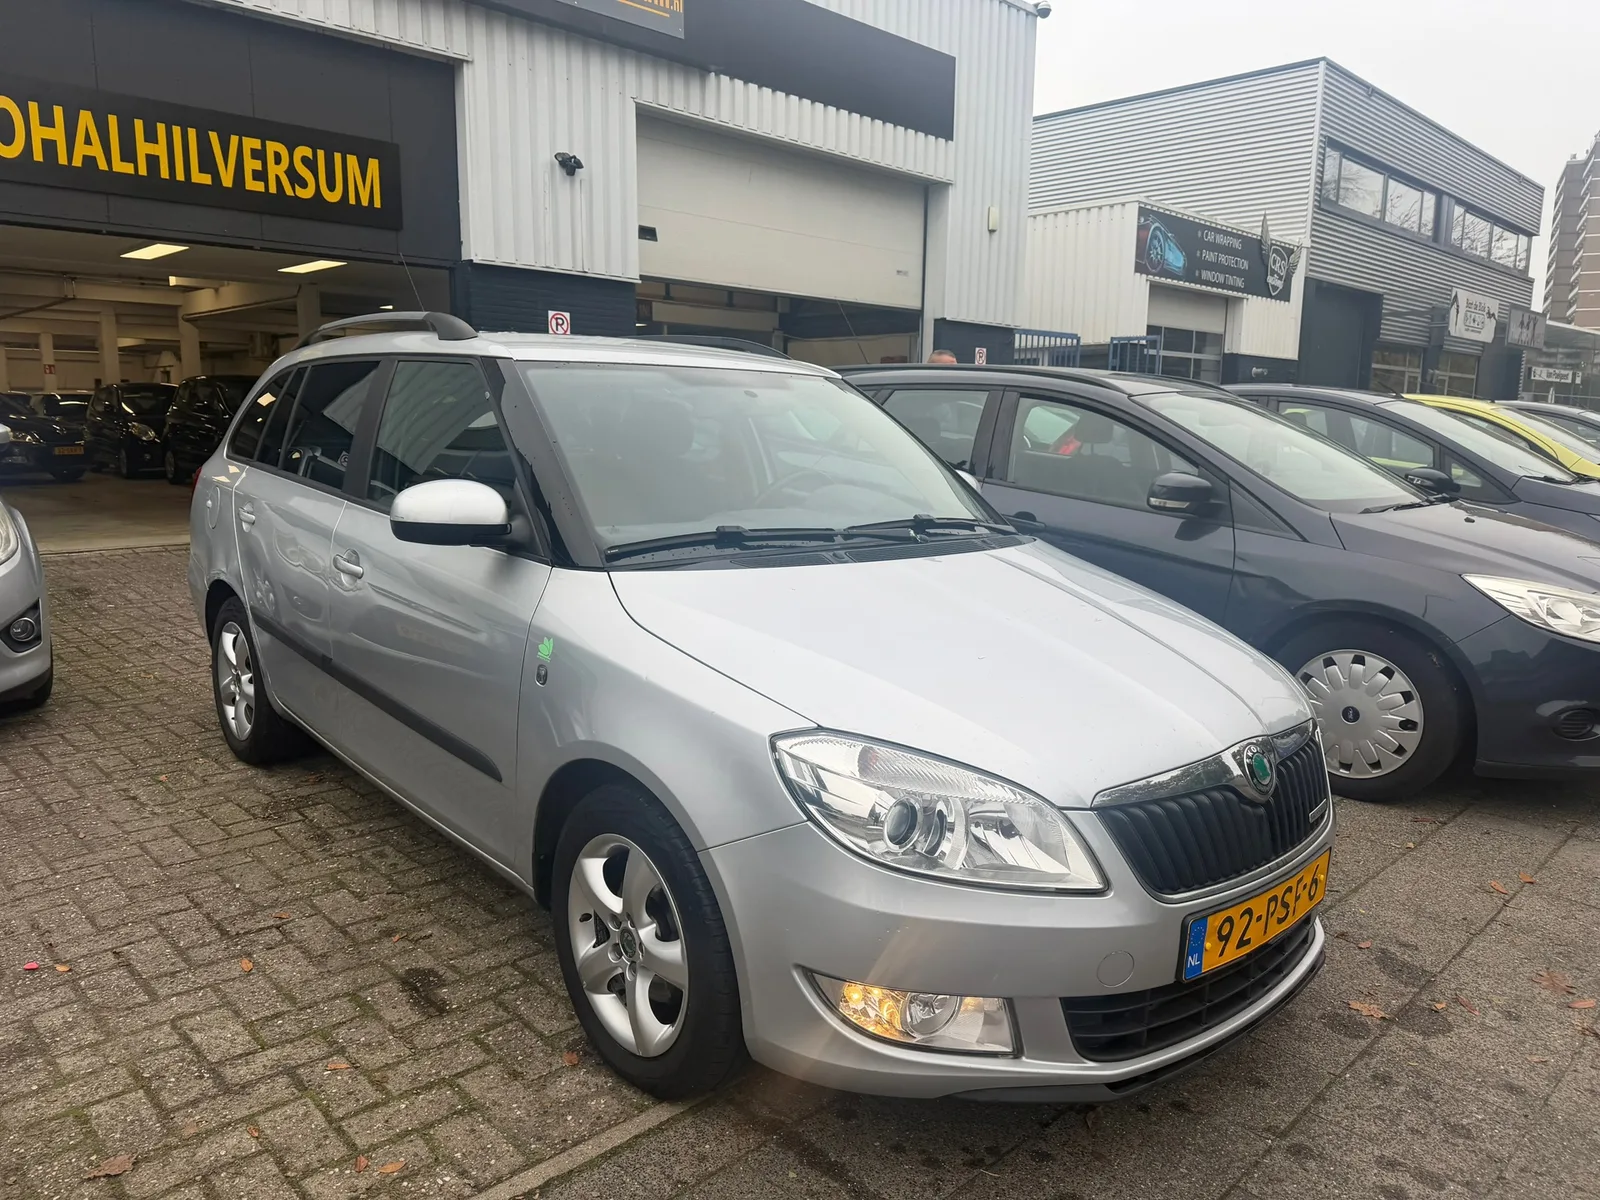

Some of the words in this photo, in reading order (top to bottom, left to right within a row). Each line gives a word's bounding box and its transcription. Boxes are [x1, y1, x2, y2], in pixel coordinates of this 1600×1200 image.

[0, 95, 382, 208] OHALHILVERSUM
[1203, 229, 1214, 243] CAR
[1215, 233, 1242, 250] WRAPPING
[1201, 249, 1218, 263] PAINT
[1218, 253, 1249, 270] PROTECTION
[1270, 253, 1286, 275] CRS
[1201, 269, 1225, 284] WINDOW
[1225, 274, 1245, 288] TINTING
[1217, 864, 1320, 957] 92-PSF-6
[1187, 953, 1200, 967] NL
